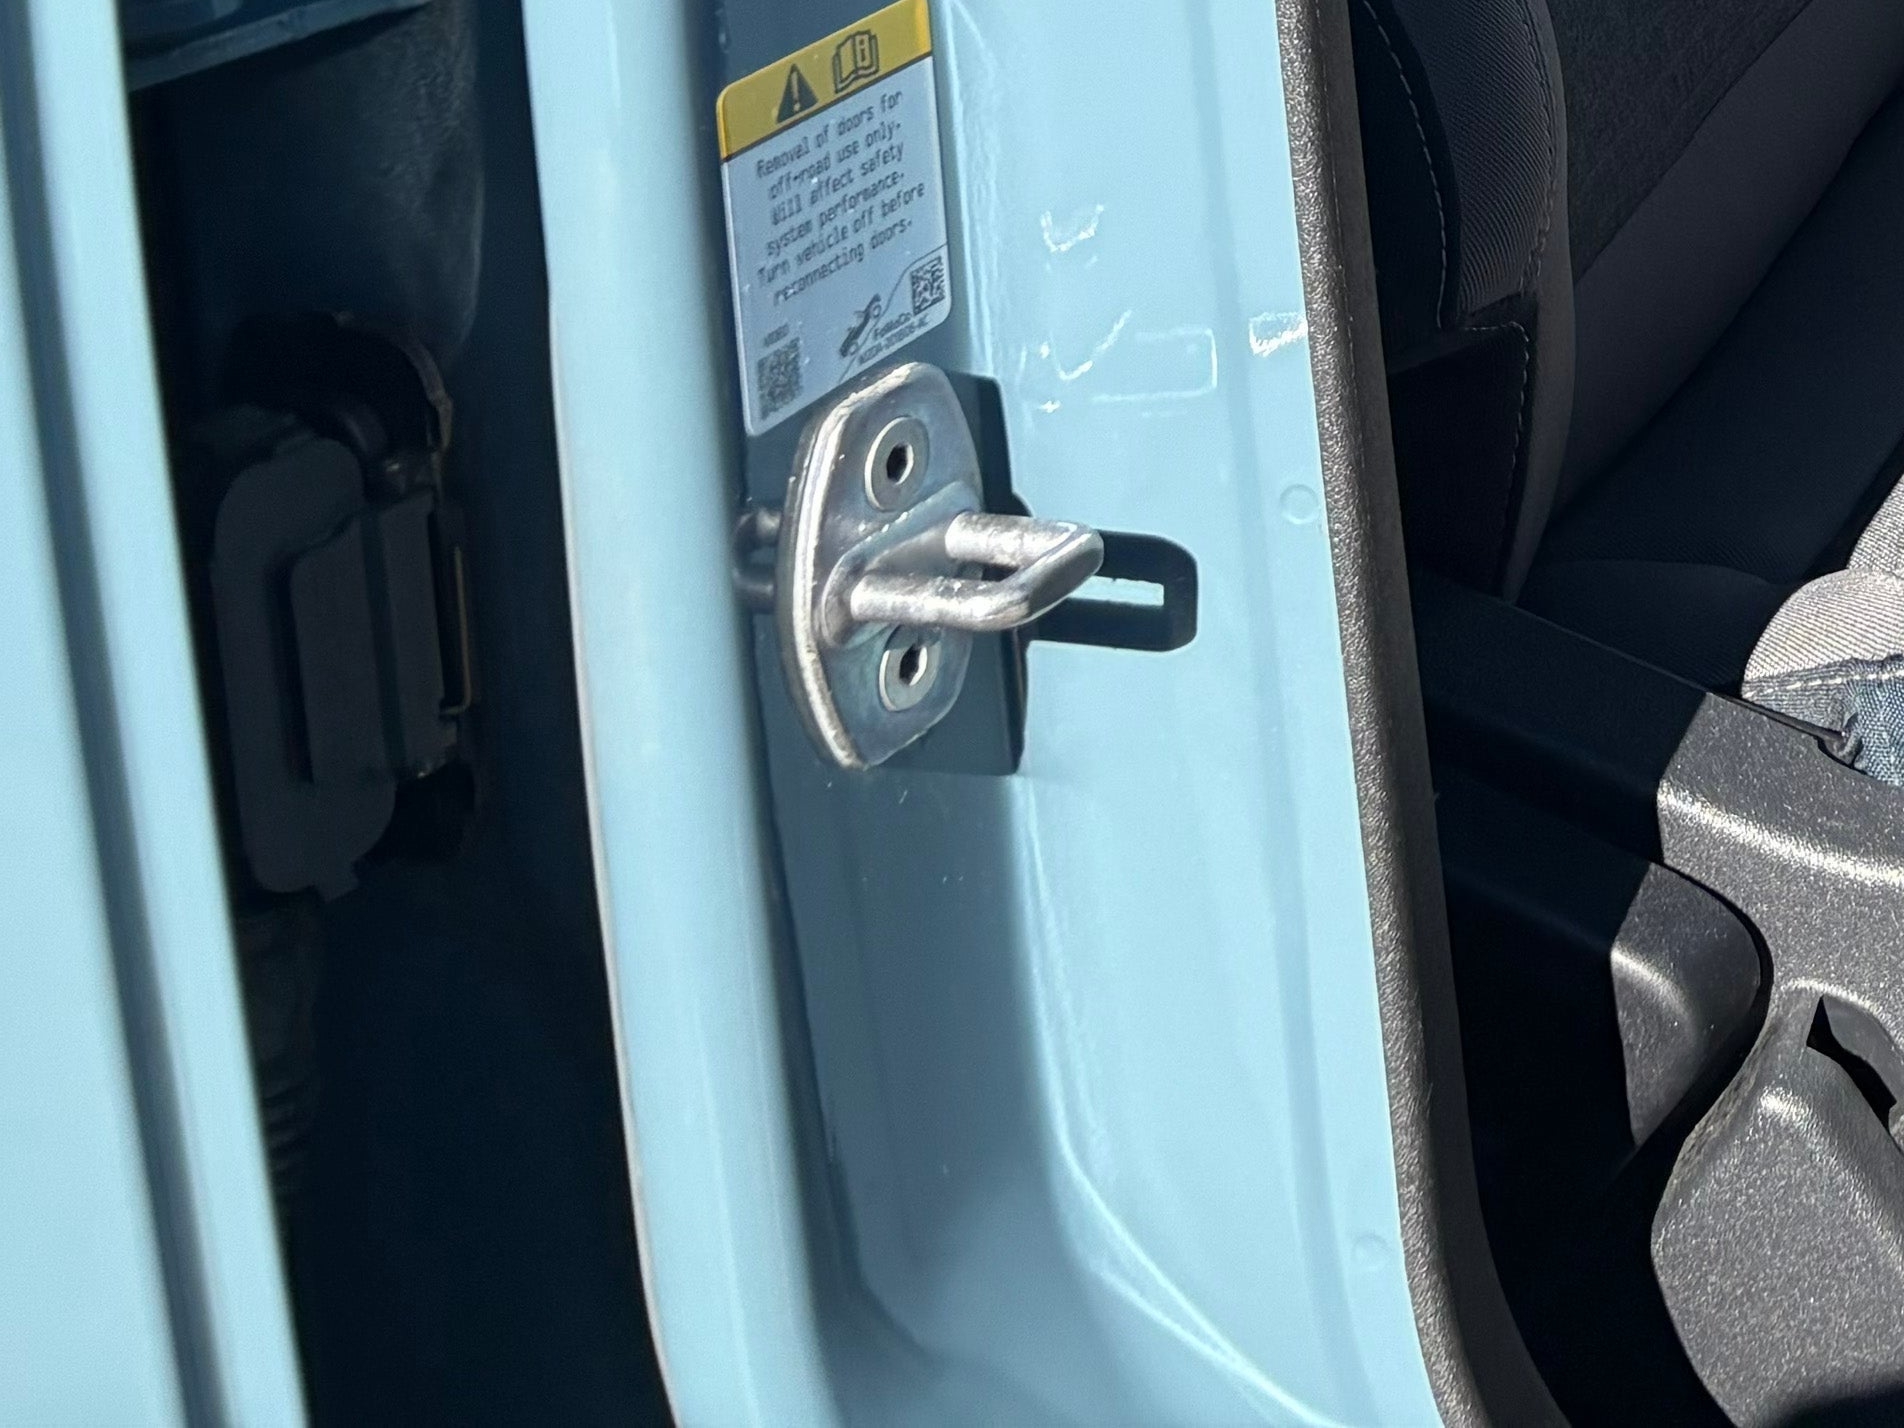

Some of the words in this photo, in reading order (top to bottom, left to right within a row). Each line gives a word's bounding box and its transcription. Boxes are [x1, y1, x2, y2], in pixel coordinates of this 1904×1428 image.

[756, 136, 811, 178] Removal
[815, 124, 829, 148] of
[837, 105, 875, 136] doors
[880, 90, 903, 113] for
[768, 150, 832, 199] off-road
[836, 140, 860, 163] use
[865, 120, 902, 148] only.
[766, 219, 813, 257] system
[818, 170, 905, 228] performance.
[772, 194, 802, 226] Will
[810, 168, 855, 206] affect
[860, 142, 904, 177] safety
[757, 258, 791, 289] Turn
[796, 225, 849, 266] vehicle
[853, 205, 875, 234] off
[880, 182, 925, 218] before
[773, 243, 865, 306] reconnecting
[870, 218, 913, 250] doors.
